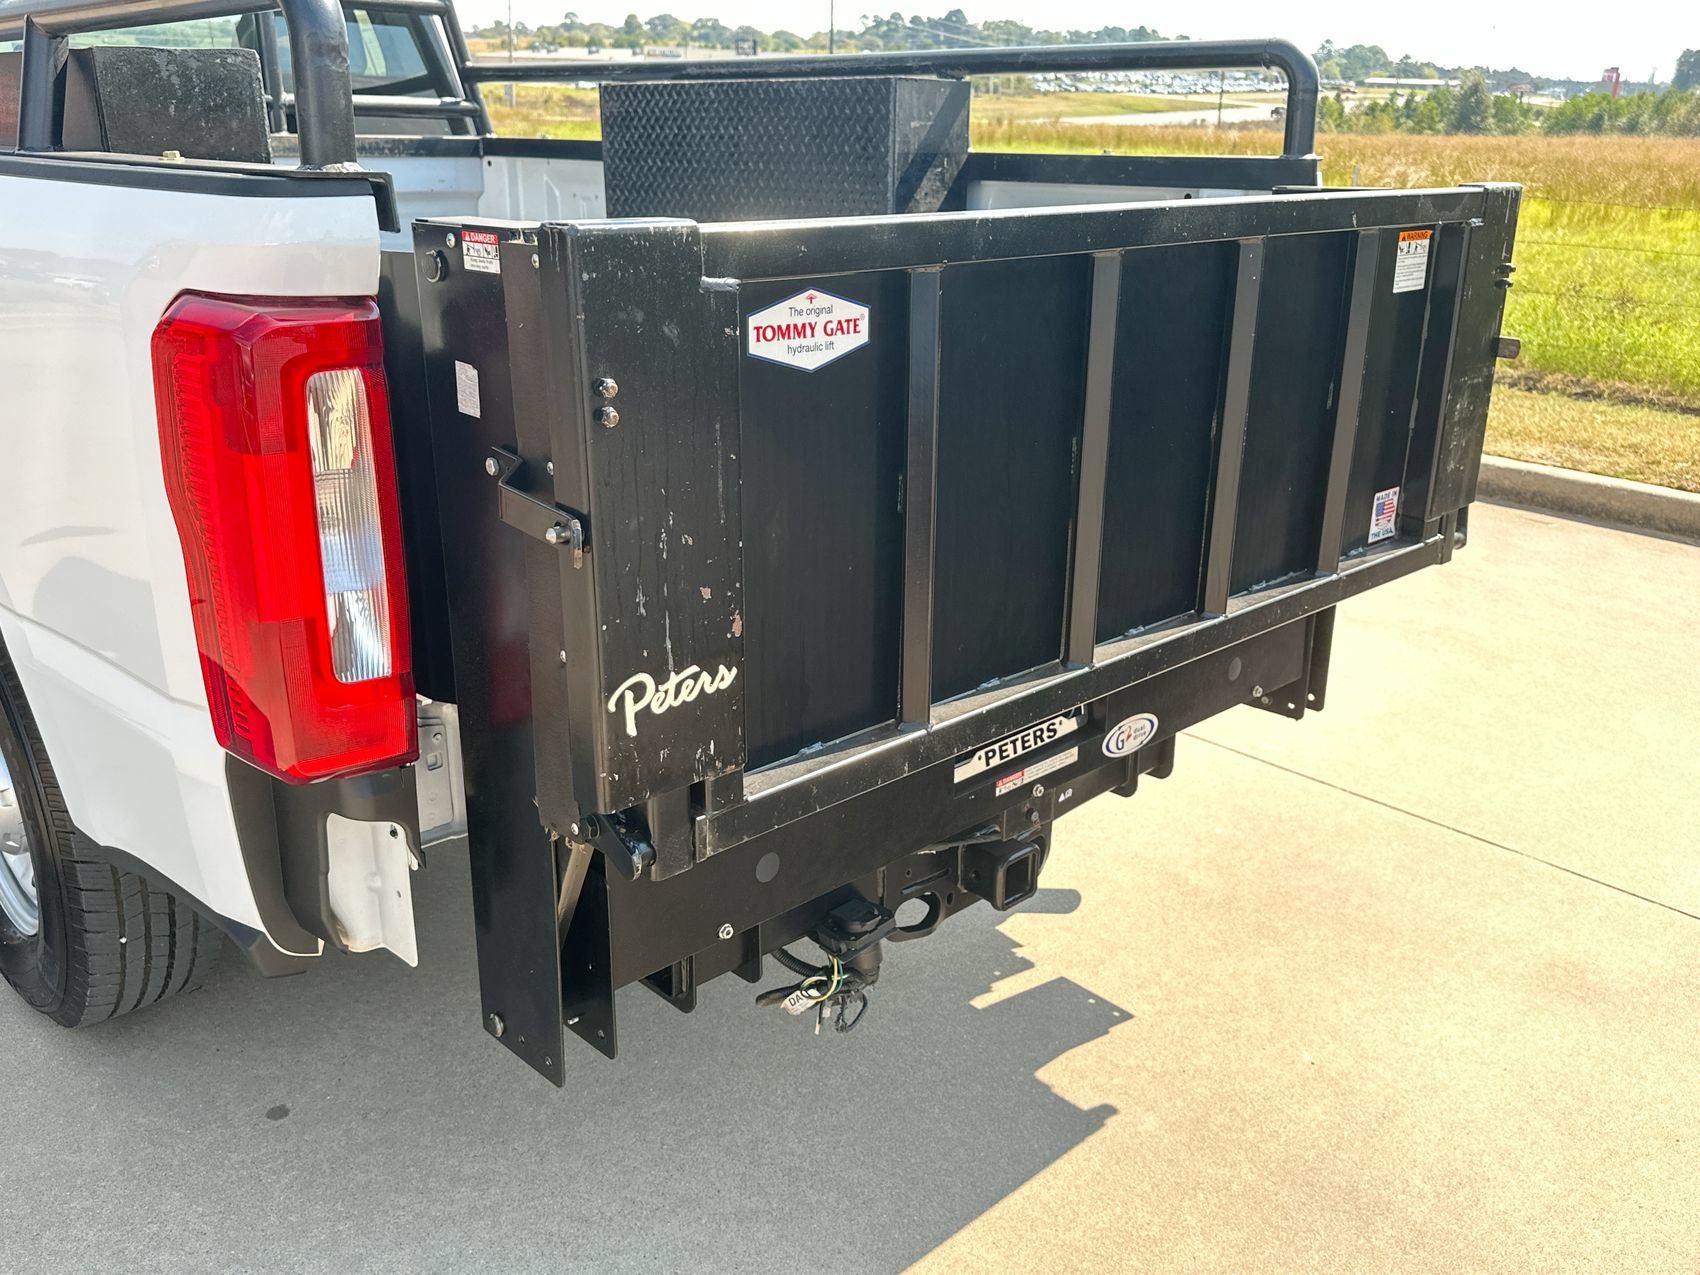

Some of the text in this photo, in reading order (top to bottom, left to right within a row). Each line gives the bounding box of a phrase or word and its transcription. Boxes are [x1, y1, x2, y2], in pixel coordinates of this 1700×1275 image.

[470, 232, 496, 244] DANGER
[1408, 231, 1428, 240] WARNING
[788, 304, 833, 317] The original
[753, 321, 817, 343] TOMMY
[787, 341, 835, 356] hydraulic lift
[1376, 492, 1391, 501] MADE
[607, 664, 738, 737] Peters
[984, 721, 1058, 767] PETERS
